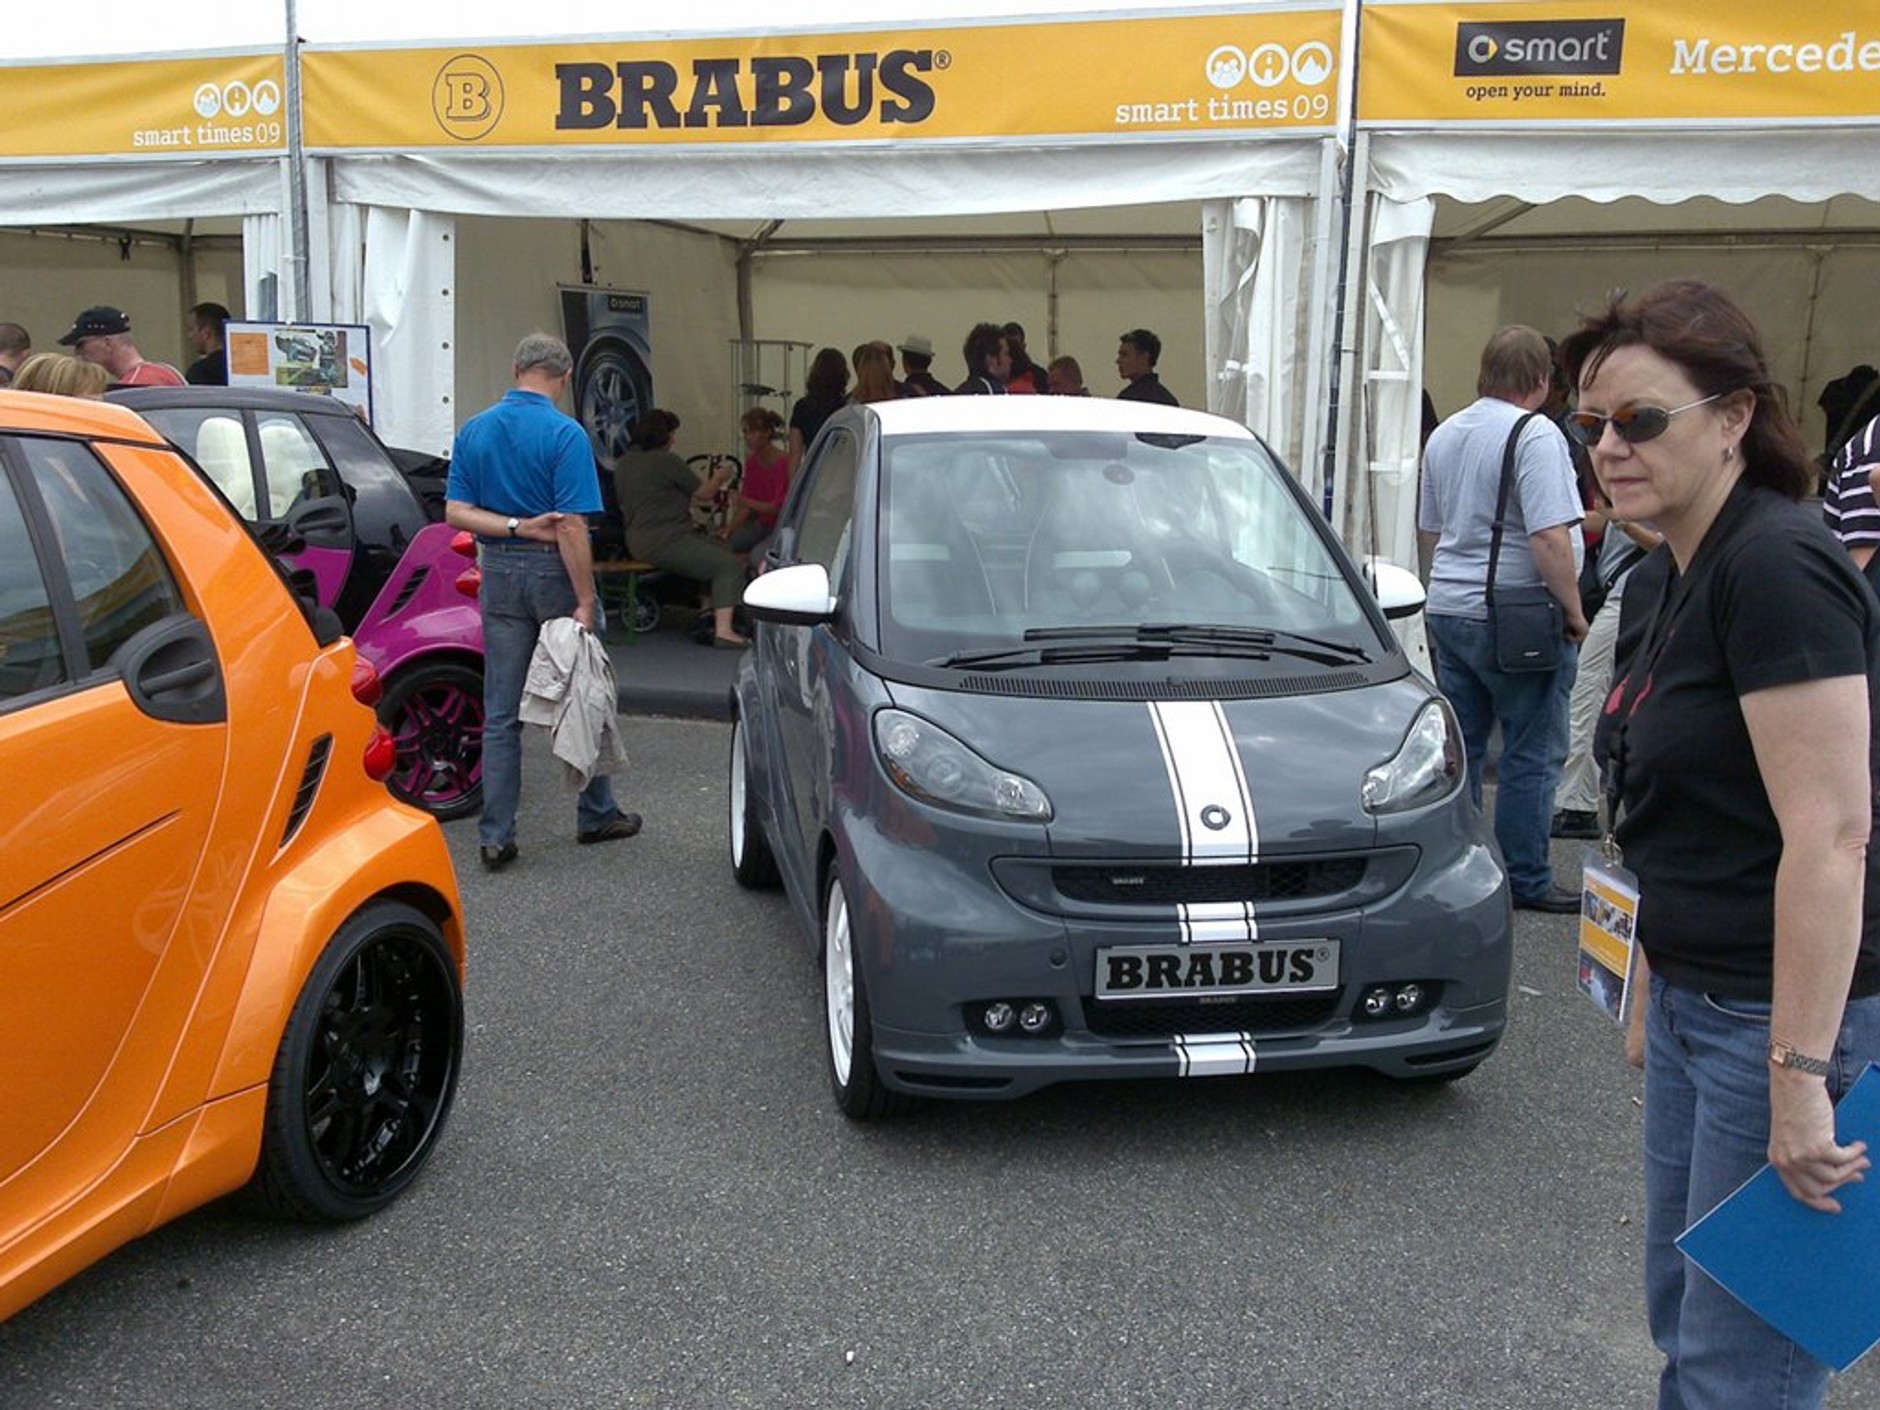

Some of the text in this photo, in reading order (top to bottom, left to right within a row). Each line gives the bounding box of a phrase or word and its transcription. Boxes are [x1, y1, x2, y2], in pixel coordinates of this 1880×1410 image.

[1504, 29, 1610, 62] smart
[1669, 31, 1880, 75] Mercede
[1466, 80, 1607, 101] open your mind.
[1115, 94, 1329, 124] smart times 09
[133, 122, 281, 146] smart times 09
